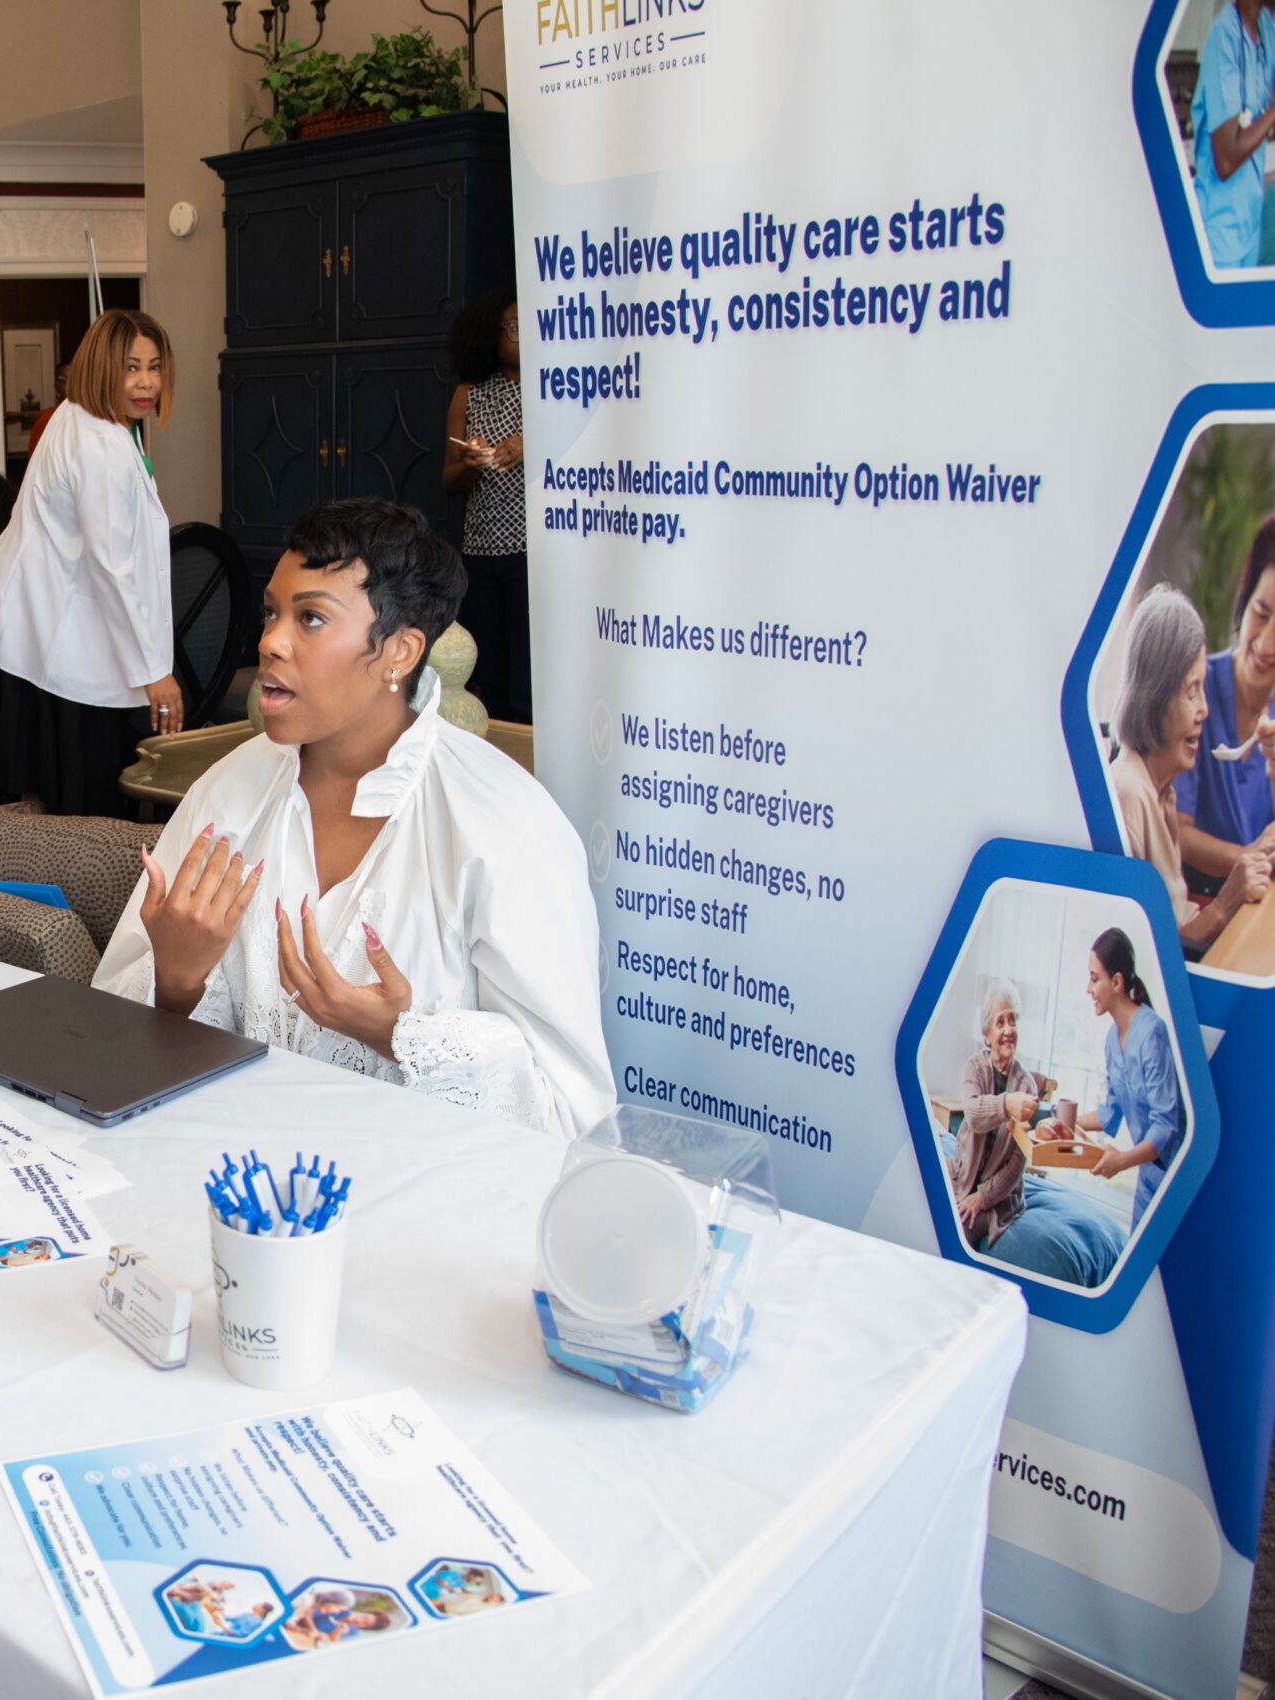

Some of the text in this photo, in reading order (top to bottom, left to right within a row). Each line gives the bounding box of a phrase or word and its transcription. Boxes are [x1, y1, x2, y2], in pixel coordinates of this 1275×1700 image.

[540, 53, 707, 94] YOUR HEALTH. YOUR HOME. OUR CARE
[575, 32, 665, 69] SERVICES
[534, 192, 1005, 282] We believe quality care starts
[537, 260, 1011, 343] with honesty, consistency and
[540, 350, 641, 408] respect!
[543, 458, 1041, 507] Accepts Medicaid Community Option Waiver
[545, 501, 685, 543] and private pay.
[596, 606, 867, 666] What Makes us different?
[622, 713, 786, 766] We listen before
[621, 772, 834, 829] assigning caregivers
[616, 829, 845, 902] No hidden changes, no
[615, 886, 748, 935] surprise staff
[617, 940, 795, 1014] Respect for home,
[617, 993, 856, 1076] culture and preferences
[624, 1065, 832, 1153] Clear communication
[9, 1167, 23, 1177] you
[35, 1163, 54, 1185] Looking
[49, 1184, 60, 1193] for
[75, 1223, 91, 1241] home
[42, 1195, 61, 1216] agency
[272, 1421, 305, 1454] respect!
[286, 1418, 387, 1542] with honesty, consistency and
[299, 1416, 399, 1537] We believe quality care starts
